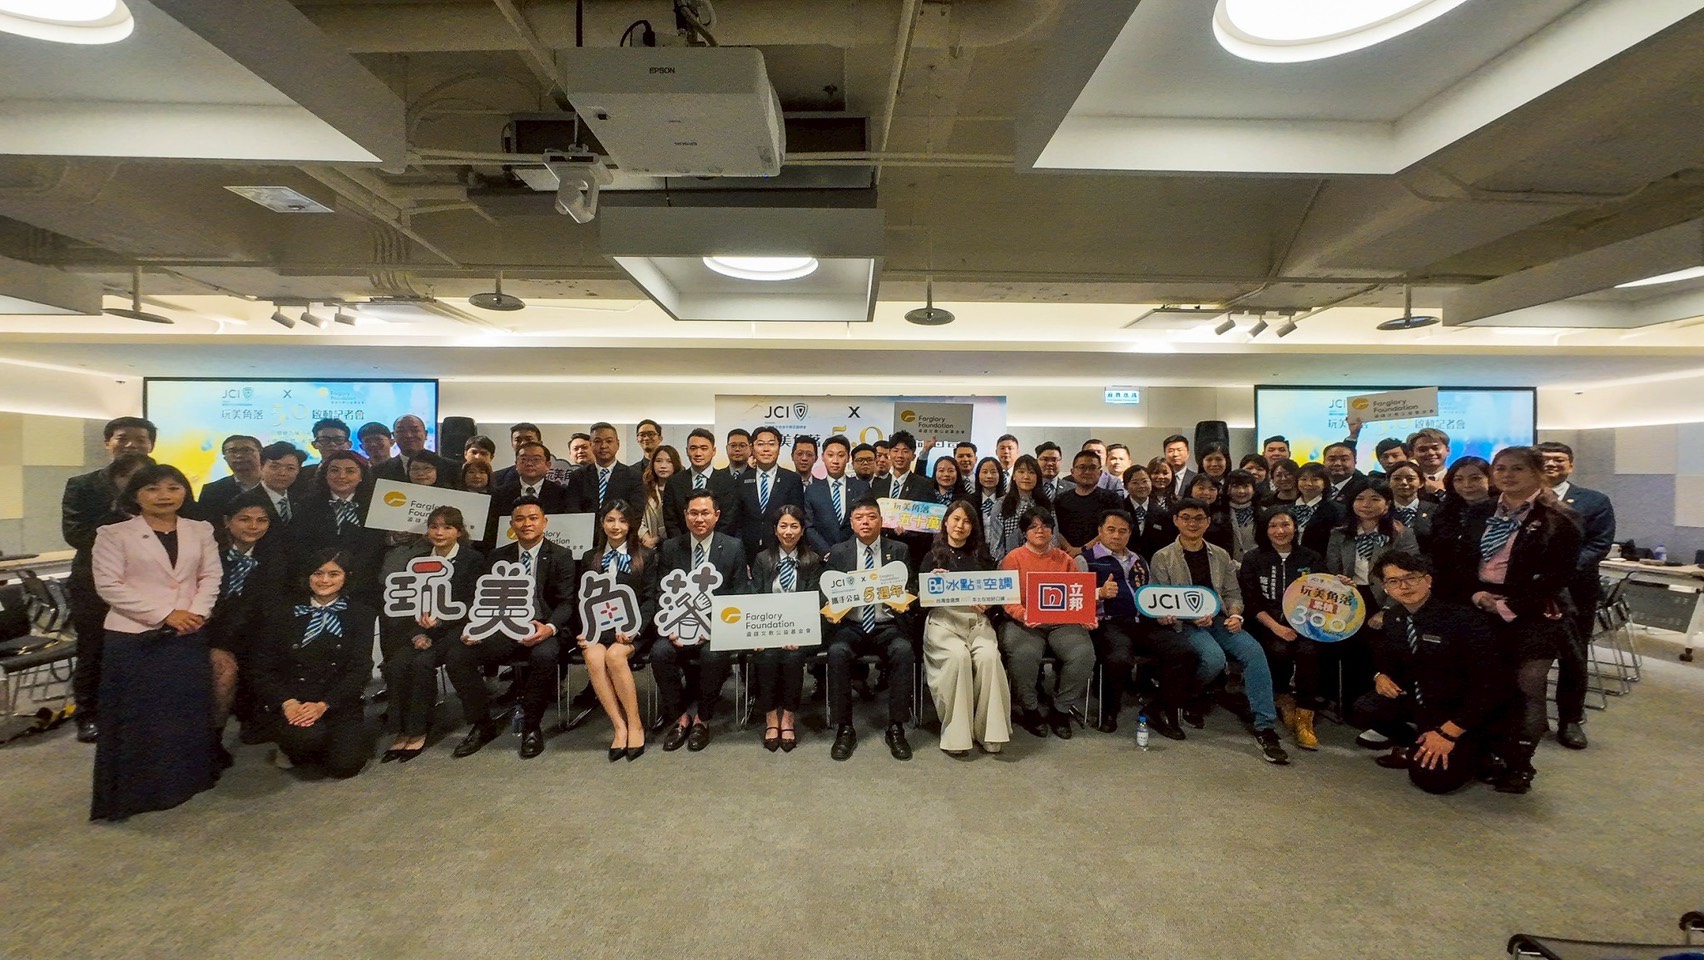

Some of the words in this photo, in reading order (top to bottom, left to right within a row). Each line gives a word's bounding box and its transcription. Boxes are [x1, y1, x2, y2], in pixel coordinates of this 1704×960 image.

[222, 389, 240, 399] JCI
[764, 405, 790, 419] JCI
[1373, 404, 1419, 414] Foundation
[918, 415, 946, 423] Farglory
[898, 513, 940, 530] 五十萬
[831, 579, 846, 588] JCI
[983, 577, 1013, 590] 空調
[469, 565, 535, 637] 美
[1069, 583, 1083, 611] 立邦
[1148, 594, 1180, 609] JCI
[745, 613, 783, 622] Farglory
[745, 621, 795, 630] Foundation
